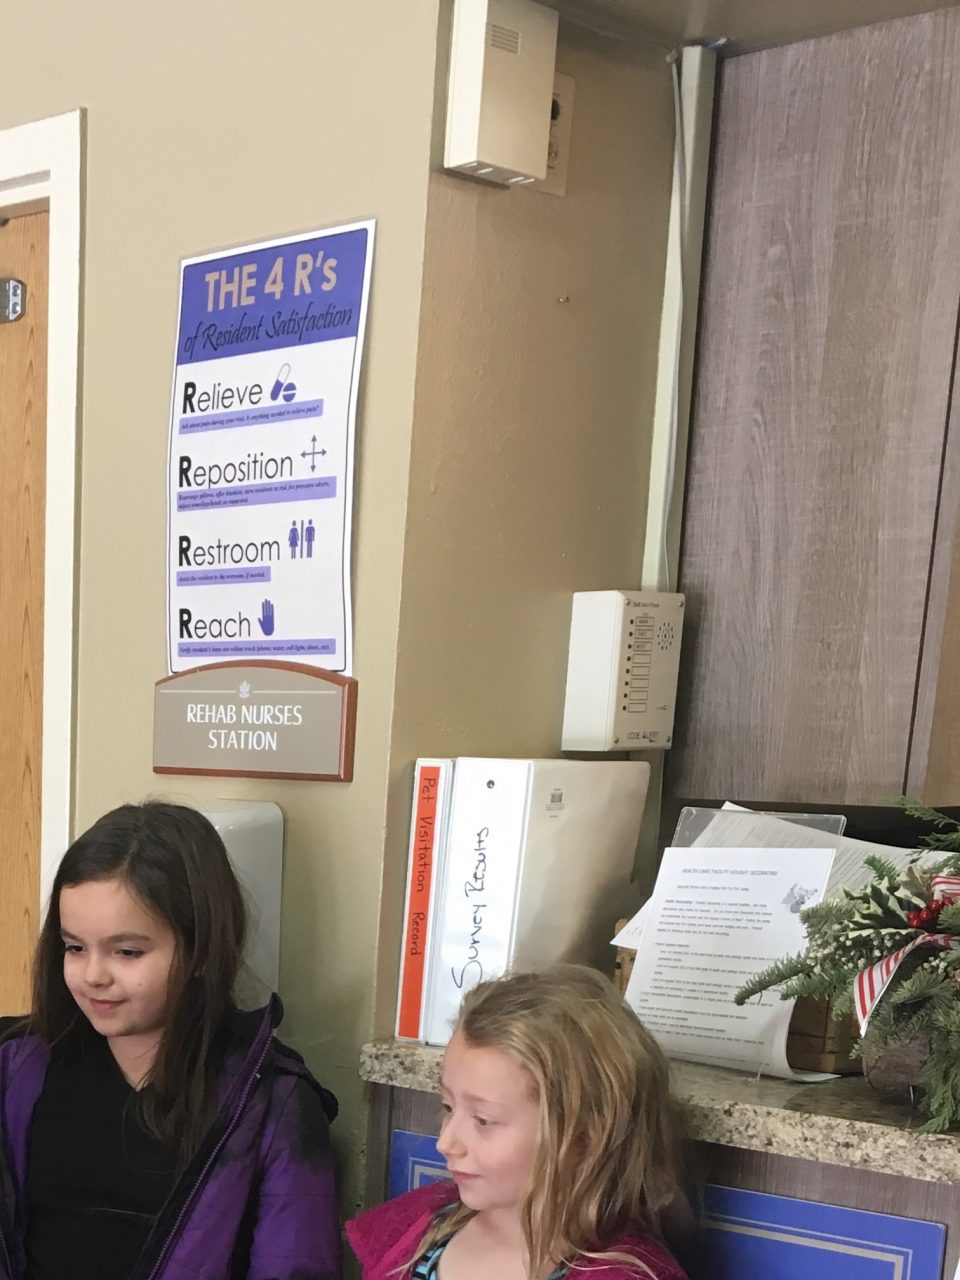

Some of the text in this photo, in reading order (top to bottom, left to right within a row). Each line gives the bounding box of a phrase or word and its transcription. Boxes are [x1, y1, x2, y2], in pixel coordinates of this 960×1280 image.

[205, 251, 338, 312] THE 4 R's
[184, 301, 353, 359] of Resident Satisfaction
[182, 381, 263, 415] Relieve
[178, 452, 293, 488] Reposition
[178, 535, 280, 566] Restroom
[178, 608, 251, 639] Reach
[187, 703, 303, 726] REHAB NURSES
[208, 729, 277, 751] STATION
[410, 777, 436, 956] Pet Visitation Record
